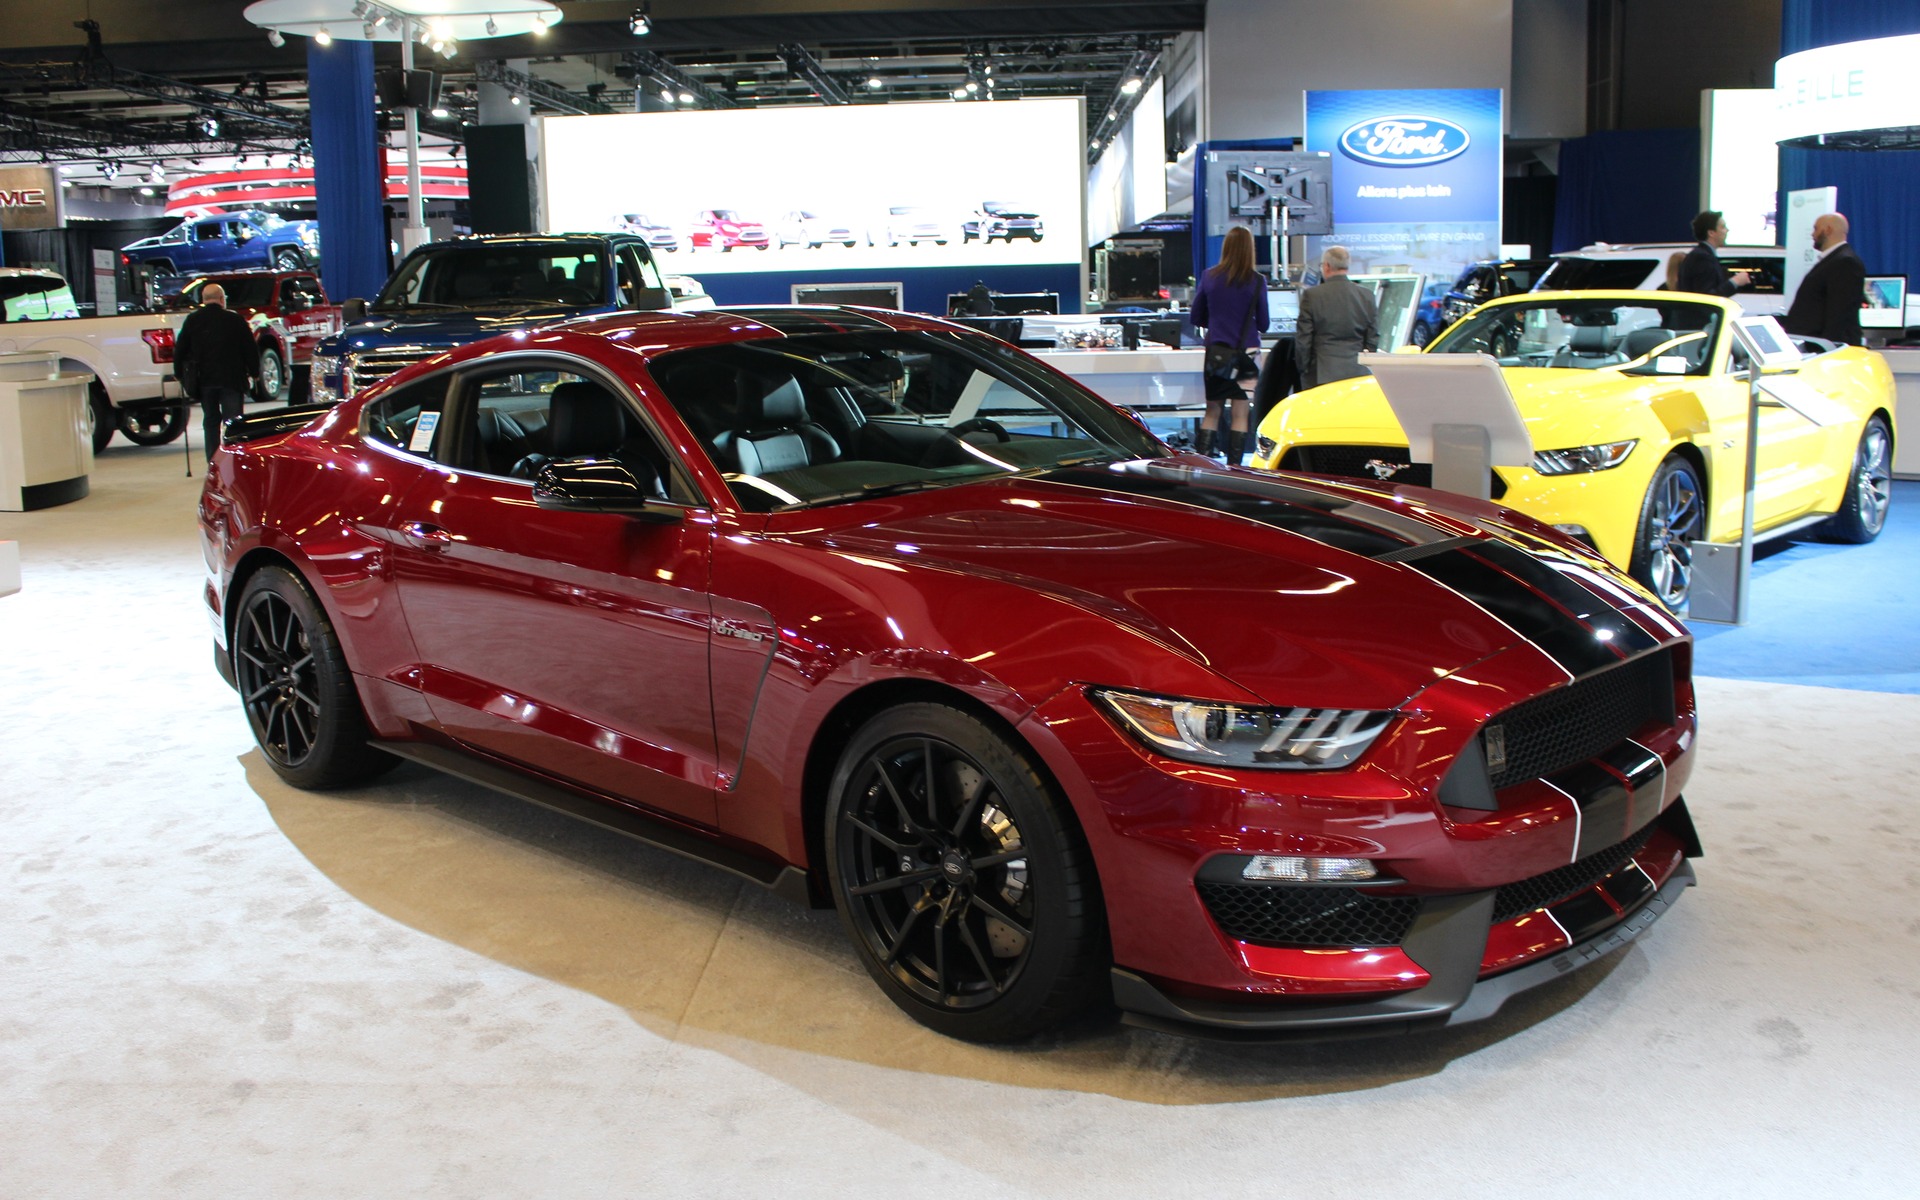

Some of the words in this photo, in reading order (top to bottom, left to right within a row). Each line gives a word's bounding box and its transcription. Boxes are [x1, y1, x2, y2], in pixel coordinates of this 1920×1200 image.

[1366, 120, 1448, 155] Ford
[1356, 185, 1397, 198] Allons
[1398, 184, 1426, 200] plus
[1426, 184, 1451, 197] loin
